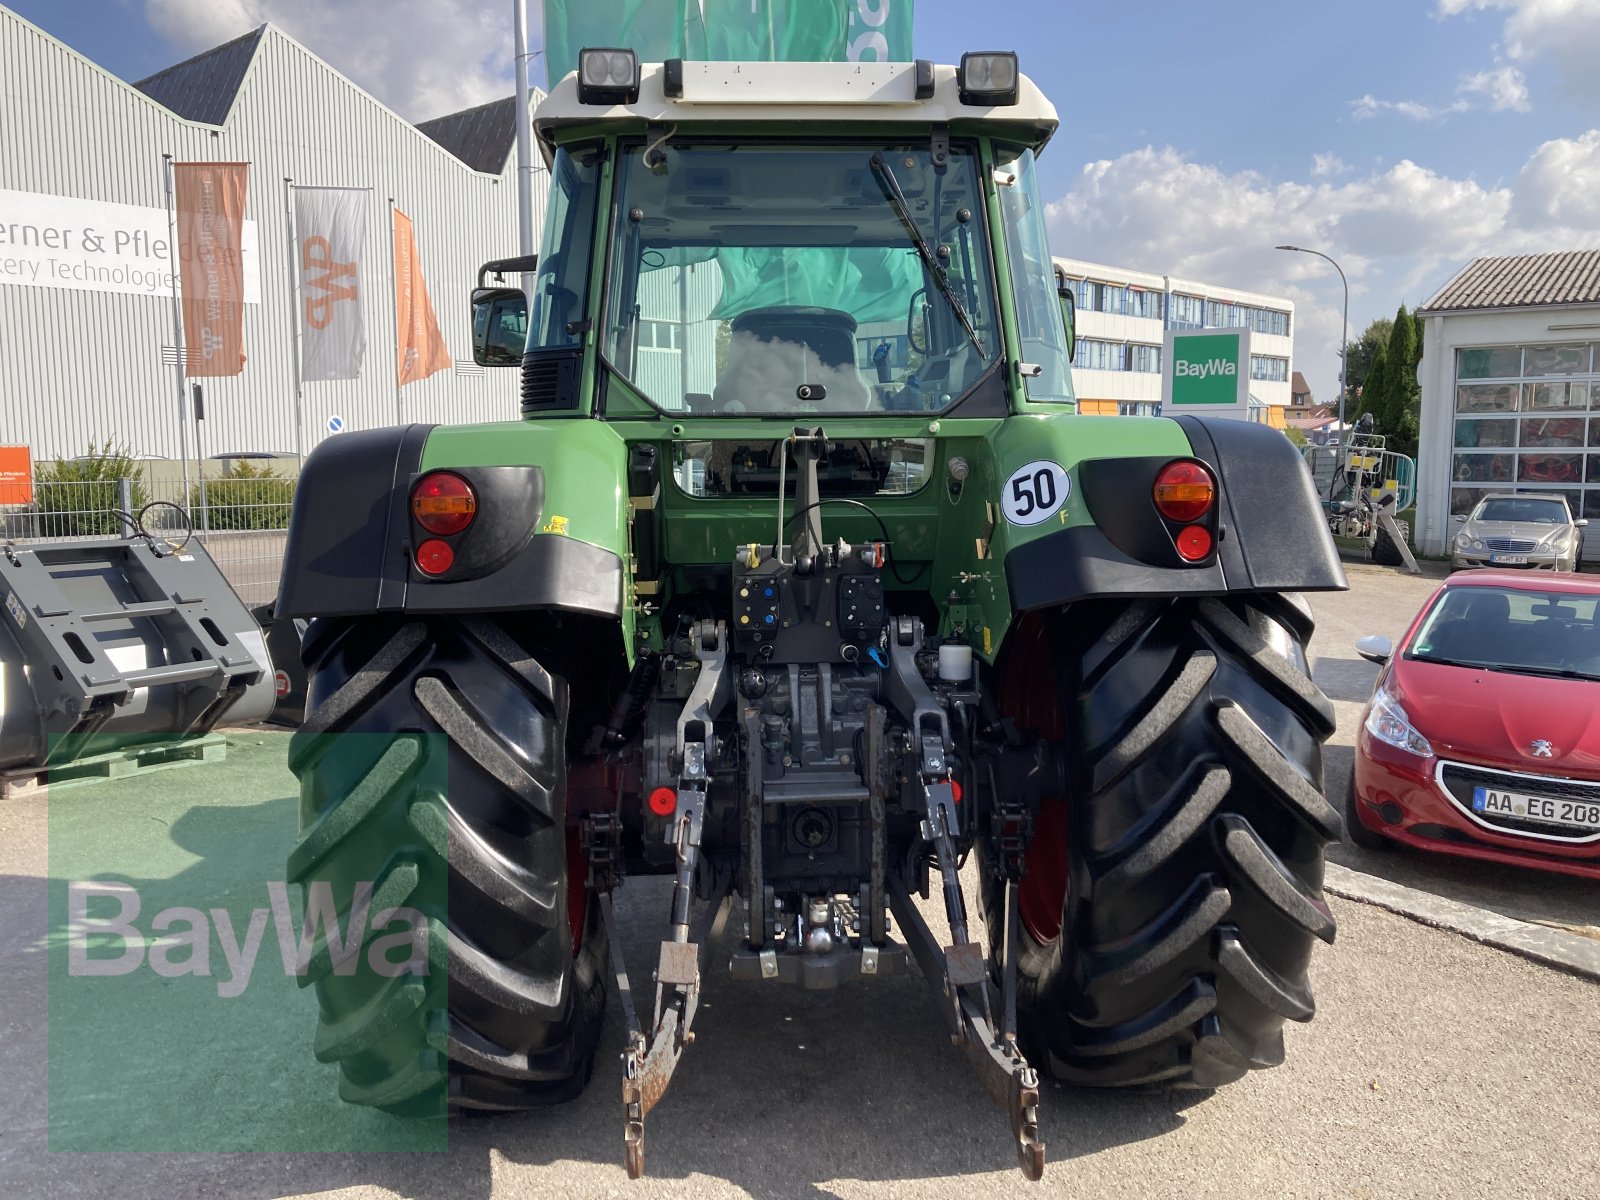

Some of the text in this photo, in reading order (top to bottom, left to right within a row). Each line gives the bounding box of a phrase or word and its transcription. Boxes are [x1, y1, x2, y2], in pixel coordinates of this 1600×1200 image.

[0, 221, 247, 266] rner & Pfledeer
[48, 258, 184, 291] Technologies
[1175, 358, 1236, 380] BayWa
[1012, 468, 1057, 517] 50
[1486, 792, 1512, 812] AA
[1527, 797, 1555, 818] EG
[1560, 803, 1600, 824] 208
